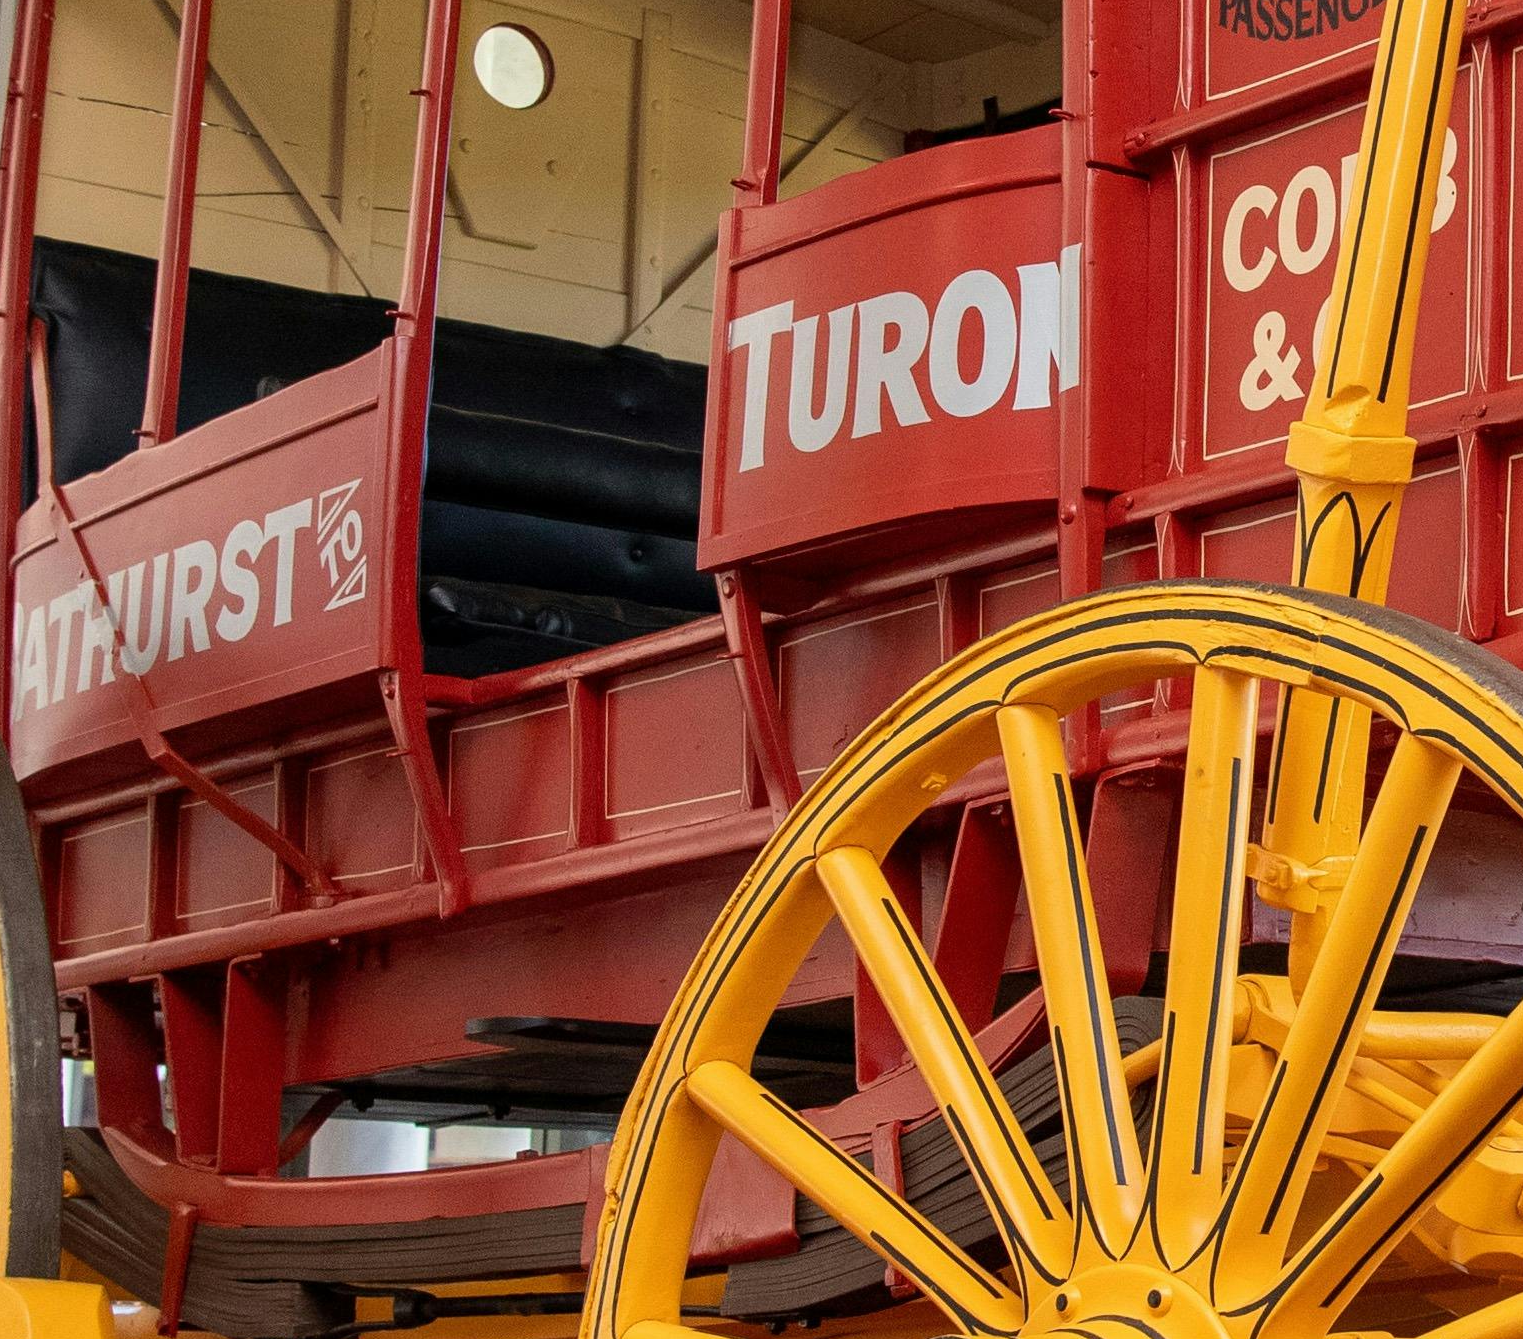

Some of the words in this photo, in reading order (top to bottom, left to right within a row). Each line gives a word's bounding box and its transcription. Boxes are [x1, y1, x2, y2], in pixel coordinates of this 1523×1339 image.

[728, 243, 1083, 473] TURON
[1239, 311, 1305, 411] &
[320, 509, 363, 588] TO
